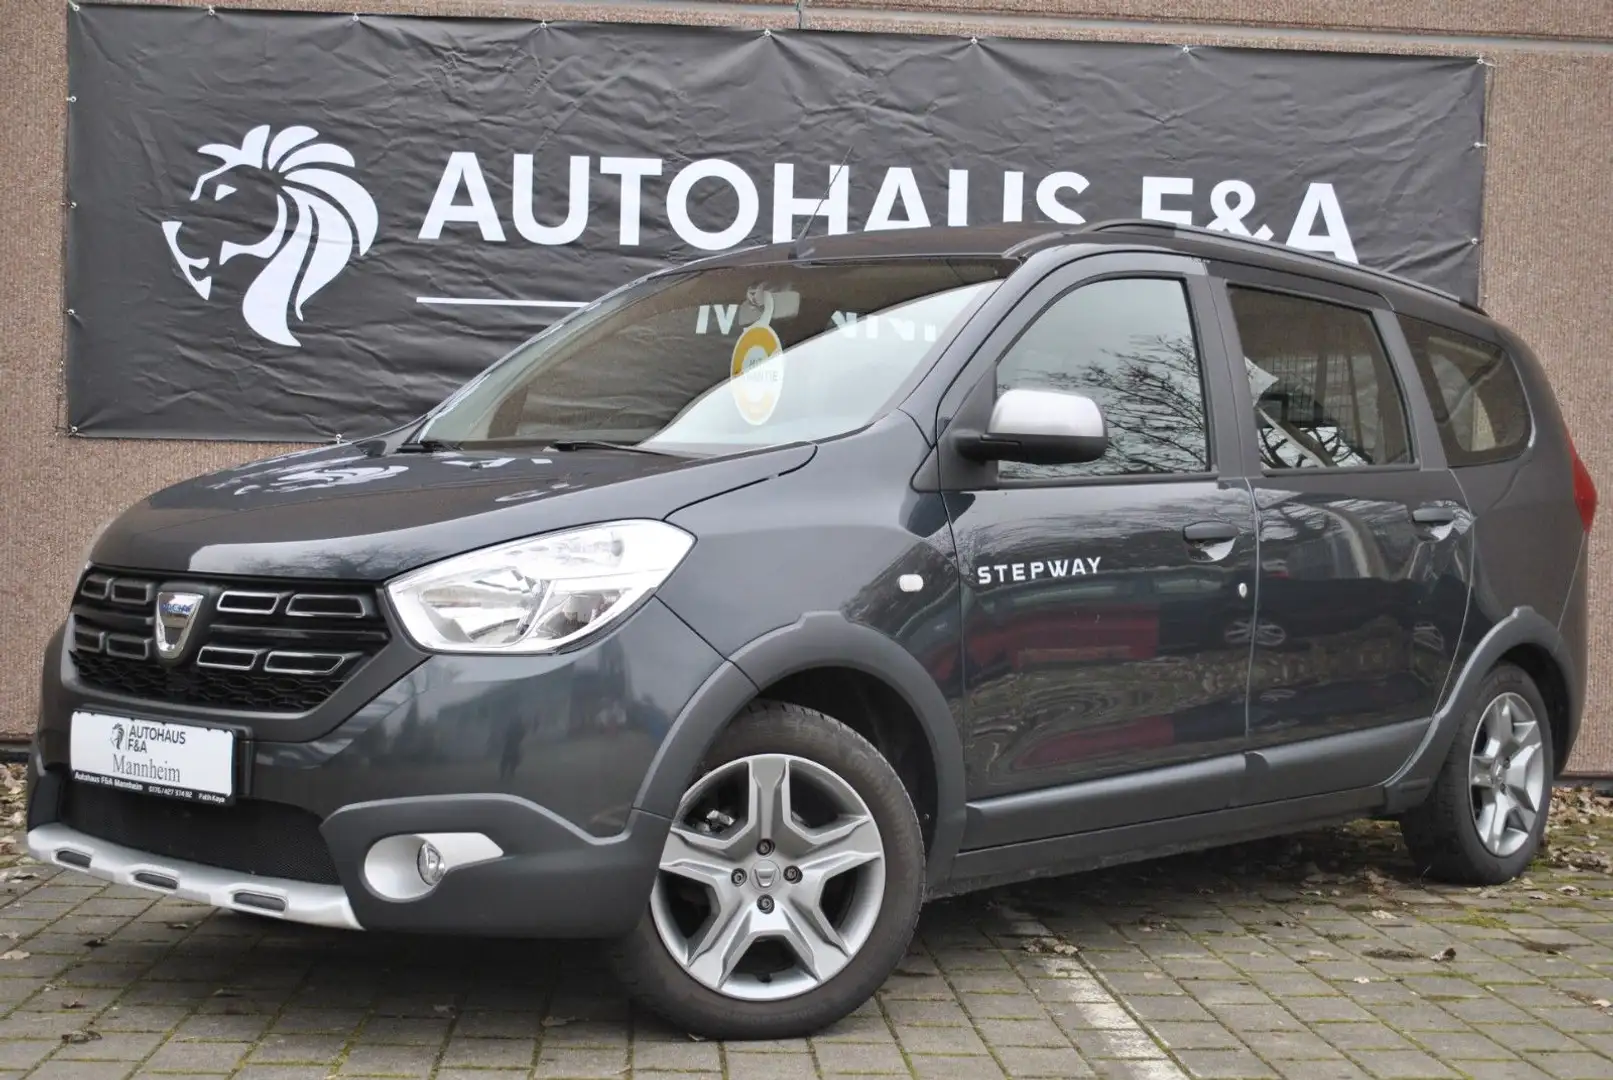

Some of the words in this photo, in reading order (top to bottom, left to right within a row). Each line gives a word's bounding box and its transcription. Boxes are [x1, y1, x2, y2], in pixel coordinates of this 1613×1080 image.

[417, 151, 1091, 252] AUTOHAUS
[977, 556, 1102, 585] STEPWAY
[128, 725, 186, 745] AUTOHAUS
[74, 771, 100, 784] Autohaus
[114, 778, 144, 792] Mannheim
[112, 752, 181, 784] Mannheim
